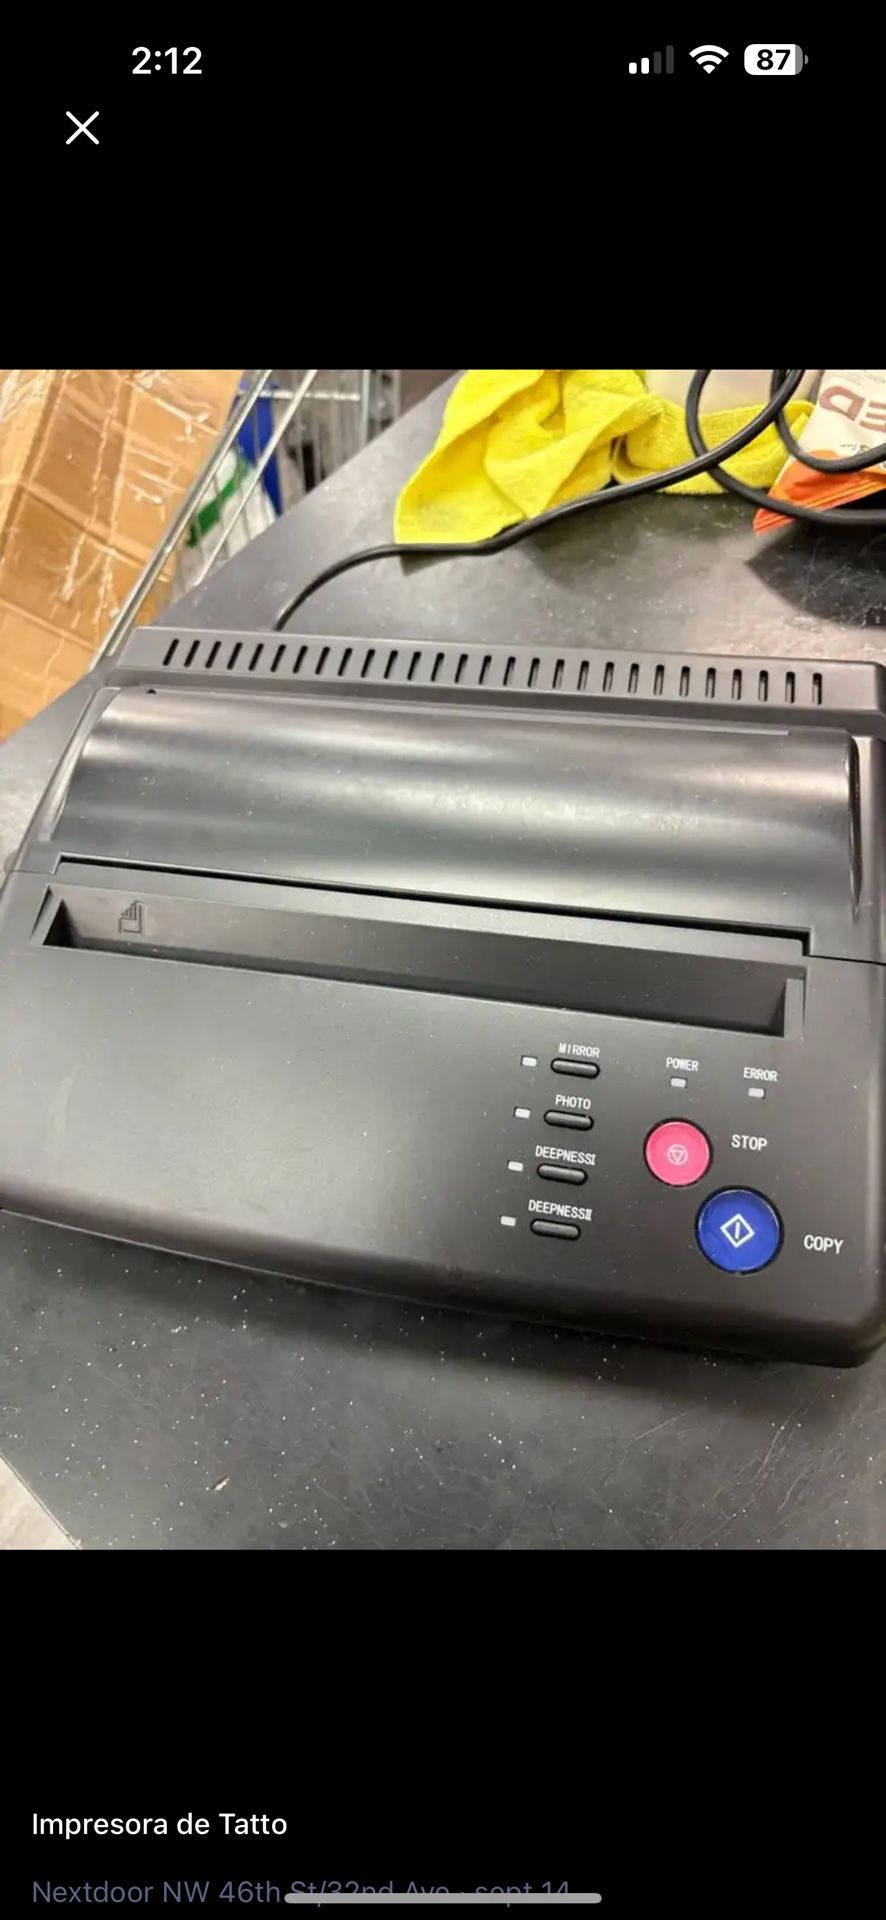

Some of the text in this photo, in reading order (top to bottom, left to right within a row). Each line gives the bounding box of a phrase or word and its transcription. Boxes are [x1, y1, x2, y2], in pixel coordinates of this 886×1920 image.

[559, 1043, 600, 1058] MIRROR
[666, 1057, 699, 1071] POWER
[743, 1067, 778, 1081] ERROR
[555, 1094, 591, 1110] PHOTO
[731, 1134, 768, 1151] STOP
[803, 1234, 844, 1255] COPY
